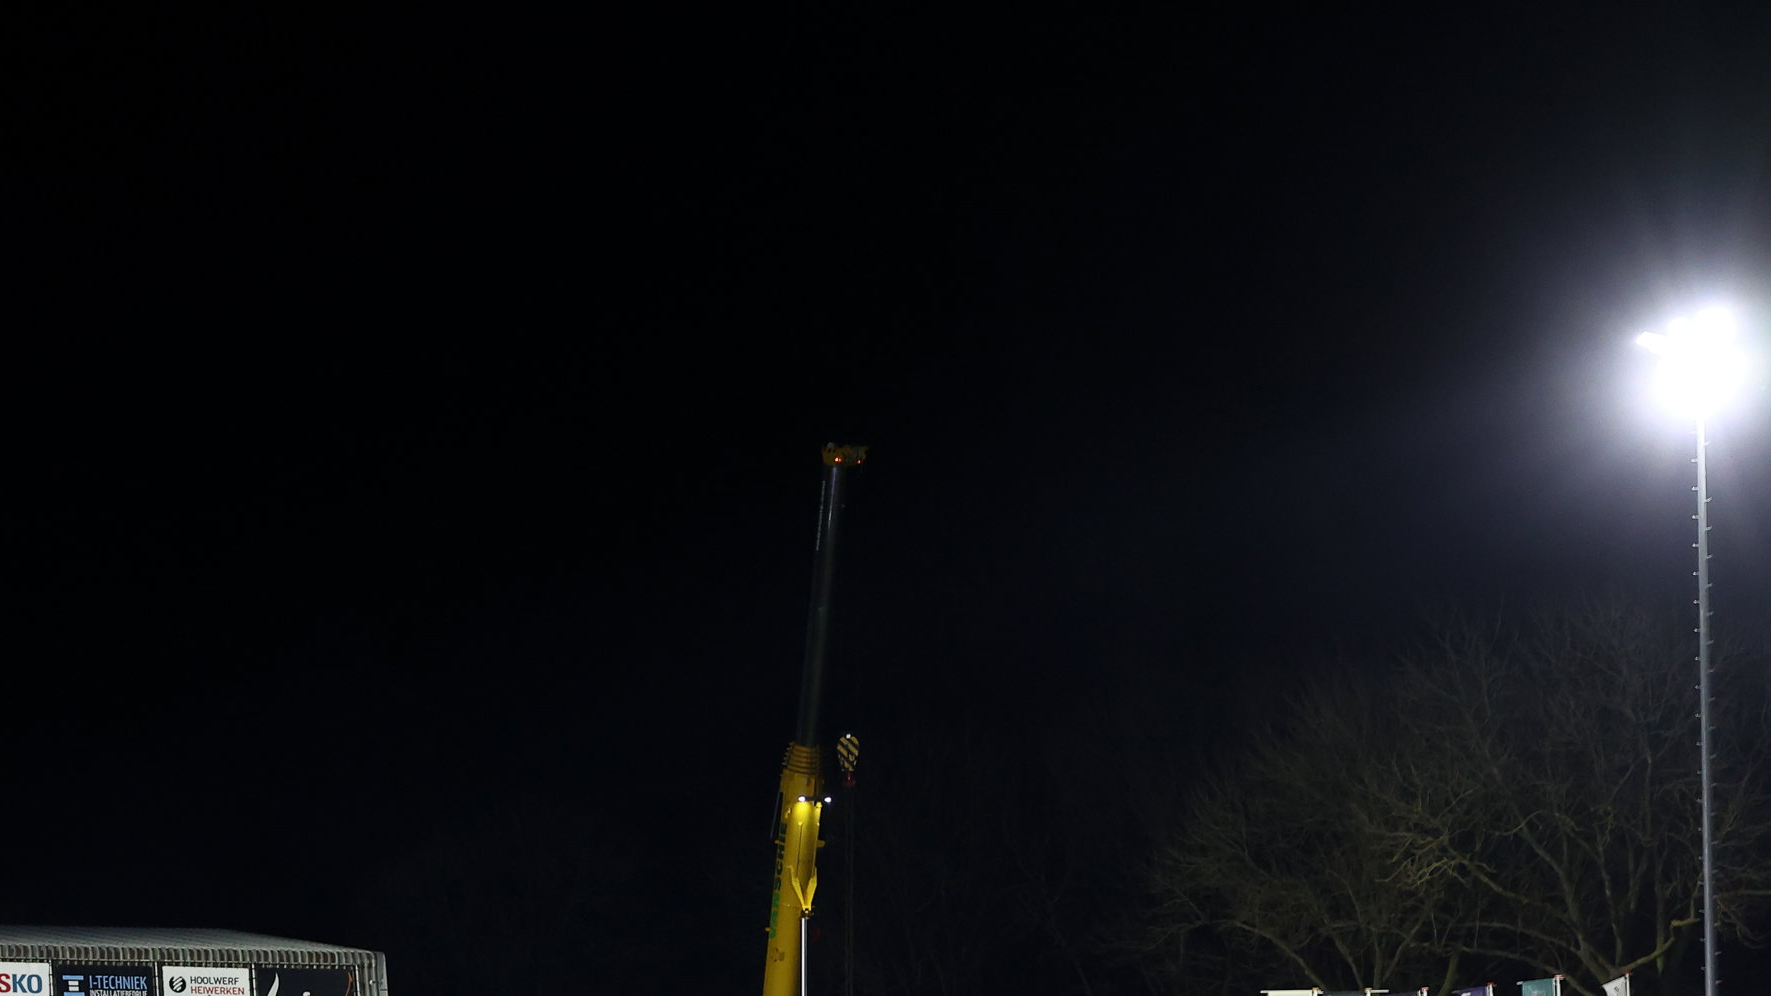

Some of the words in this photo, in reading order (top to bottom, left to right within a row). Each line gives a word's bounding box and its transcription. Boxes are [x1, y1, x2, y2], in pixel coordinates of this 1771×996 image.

[89, 975, 148, 990] I-TECHNIEK
[190, 976, 240, 985] HOOLWERF
[190, 986, 245, 995] HEIWERKEN
